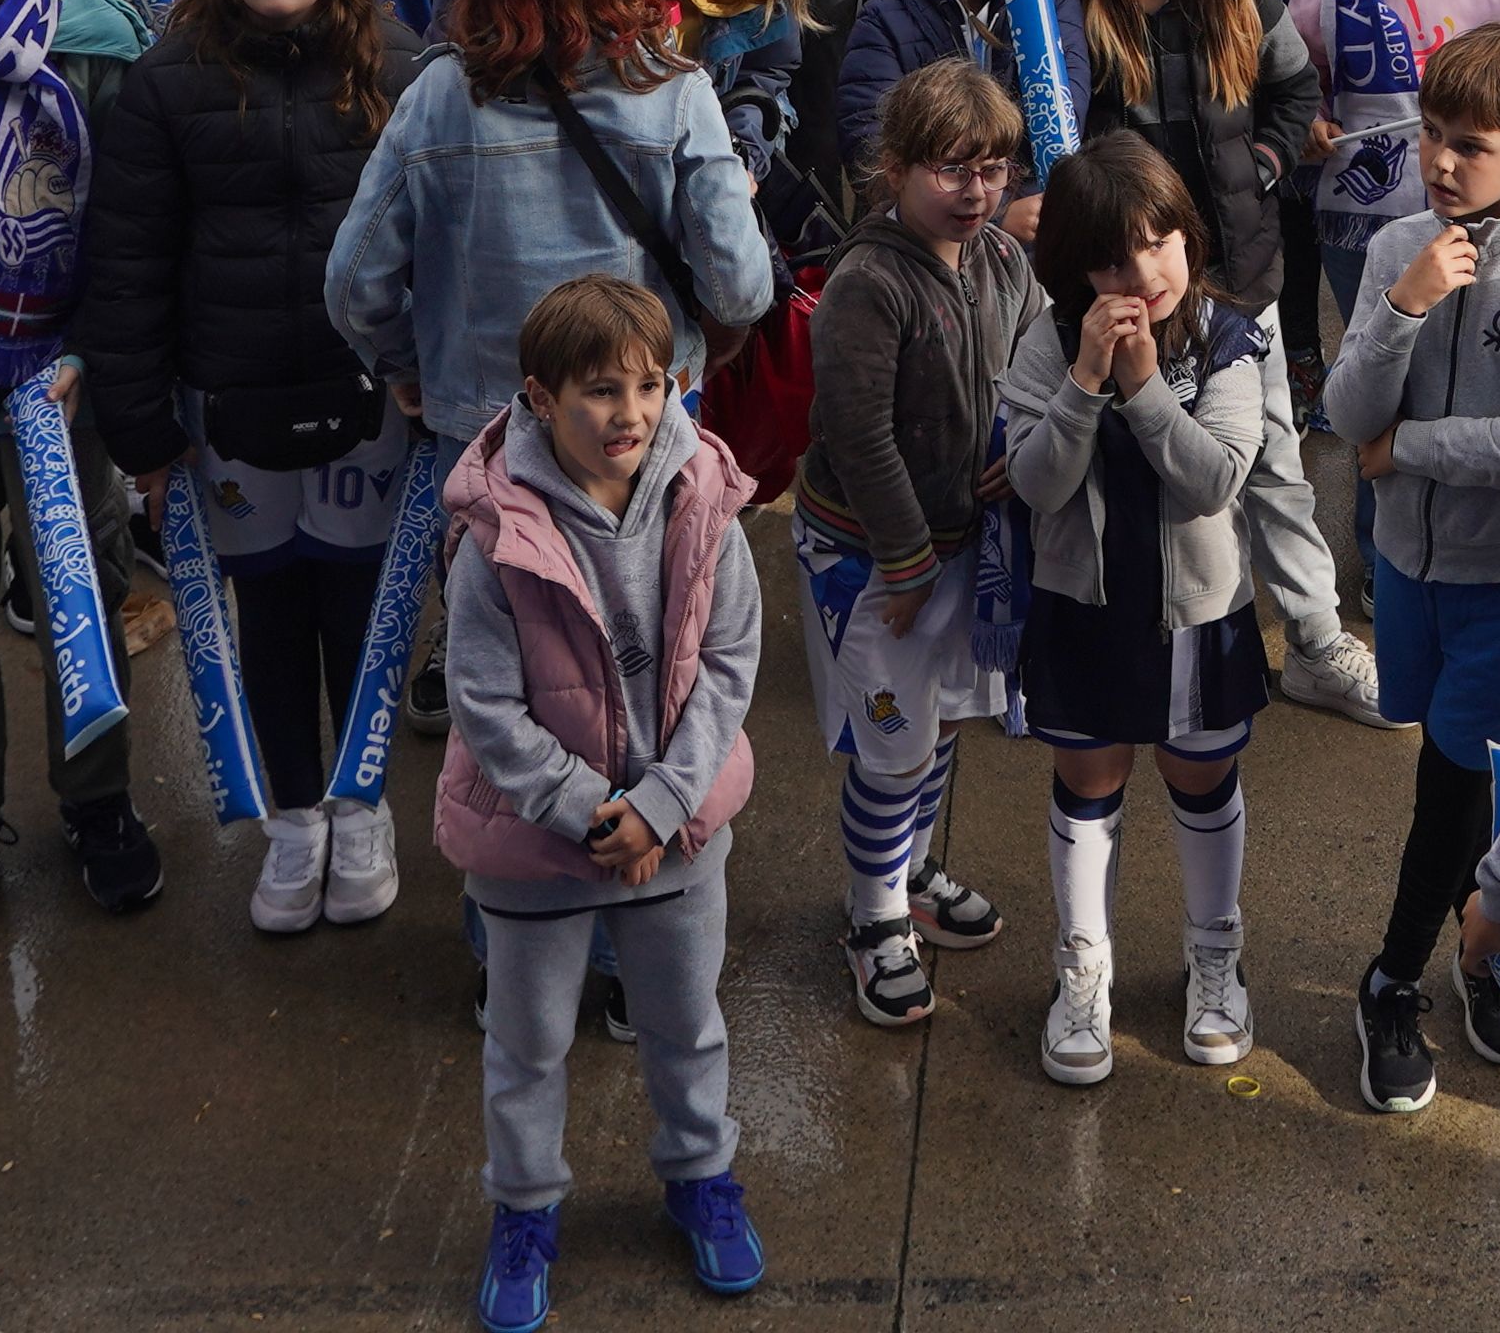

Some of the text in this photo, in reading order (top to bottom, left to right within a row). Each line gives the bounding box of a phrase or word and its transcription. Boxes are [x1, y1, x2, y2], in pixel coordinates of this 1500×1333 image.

[316, 464, 366, 510] 10
[56, 646, 91, 719] eitb
[355, 707, 391, 789] eitb
